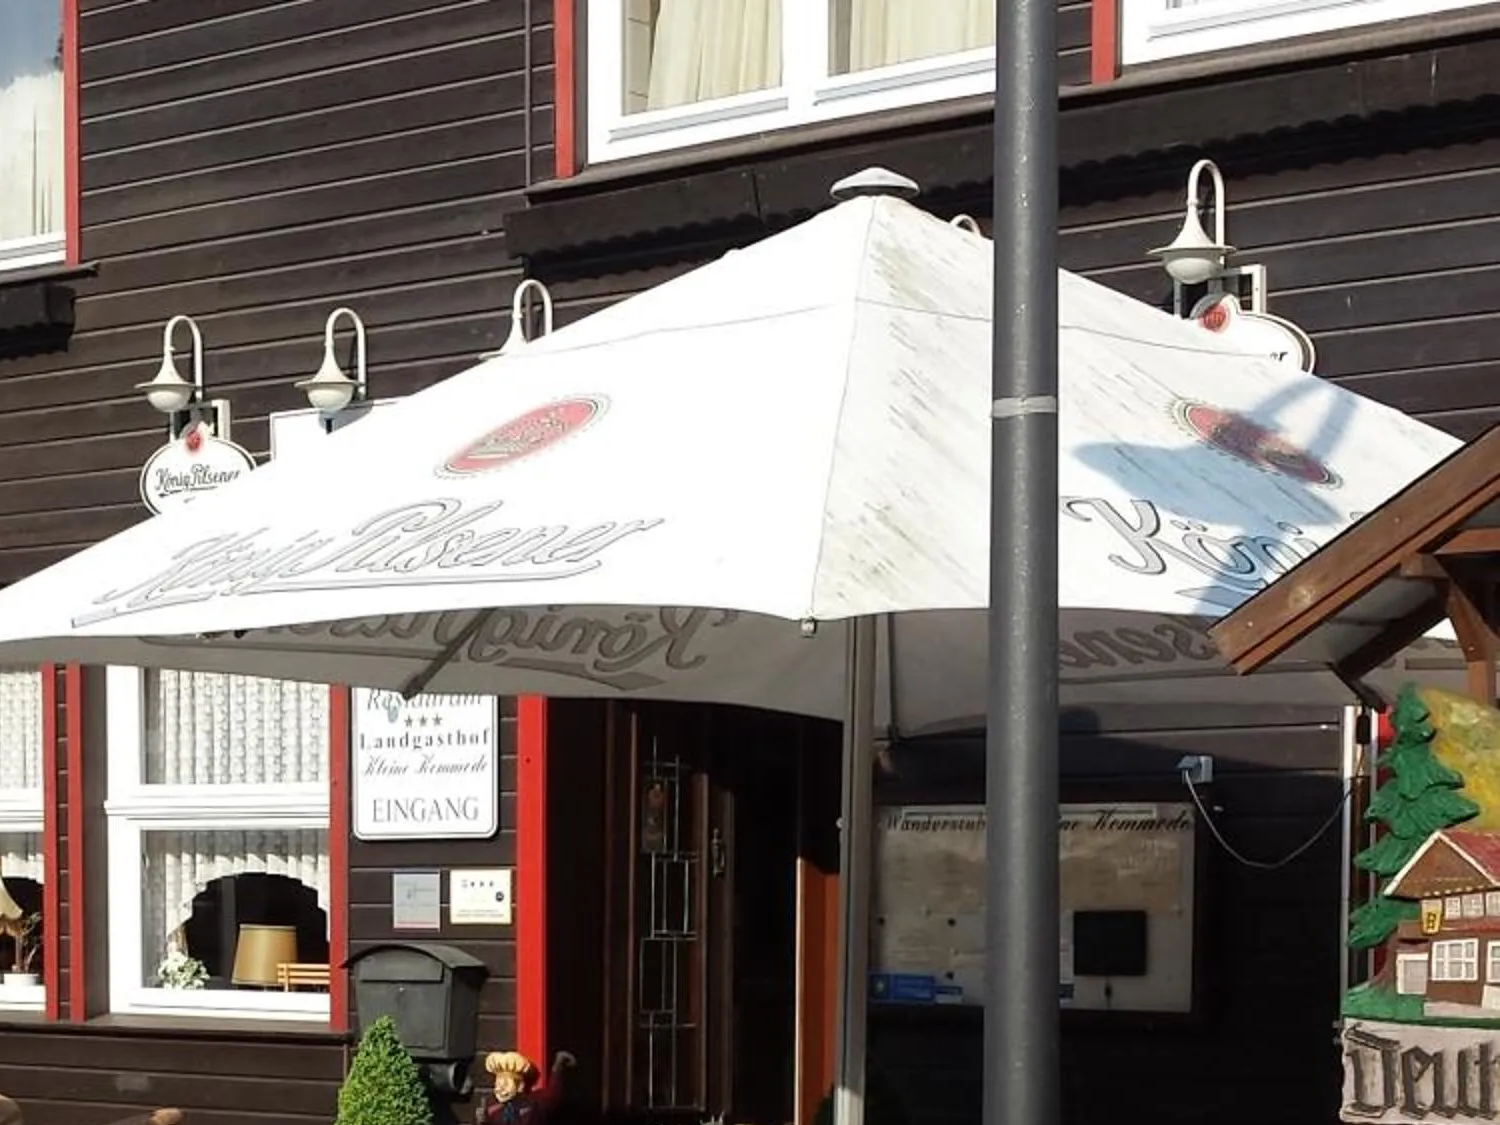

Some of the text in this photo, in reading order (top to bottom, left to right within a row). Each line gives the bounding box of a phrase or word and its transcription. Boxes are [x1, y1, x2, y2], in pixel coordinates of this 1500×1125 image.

[190, 463, 240, 487] Pilsener
[360, 728, 490, 751] Landgasthof
[373, 796, 479, 823] EINGANG
